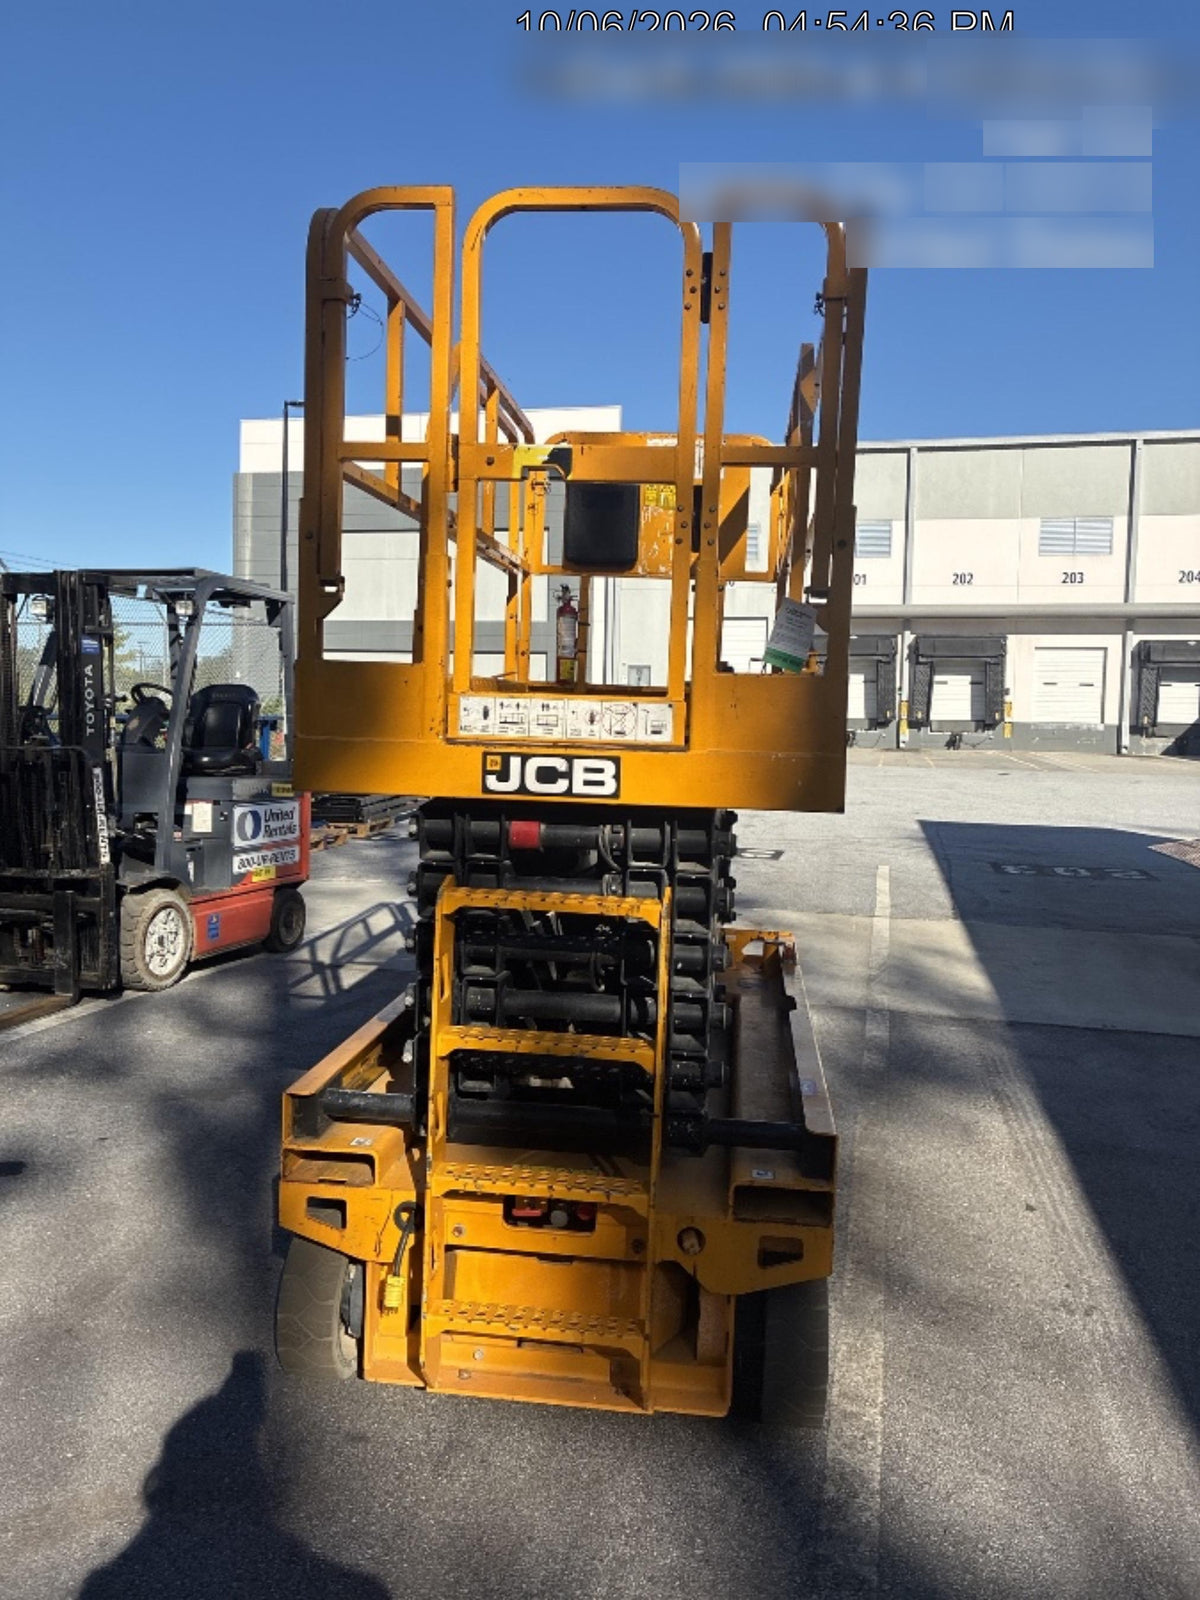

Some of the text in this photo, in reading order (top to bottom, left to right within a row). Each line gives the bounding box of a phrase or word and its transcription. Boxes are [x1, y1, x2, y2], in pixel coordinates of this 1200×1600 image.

[952, 572, 974, 585] 202
[1061, 571, 1084, 584] 203
[84, 664, 95, 736] TOYOTA
[485, 755, 617, 796] JCB
[264, 808, 294, 823] United
[264, 823, 297, 839] Rentals
